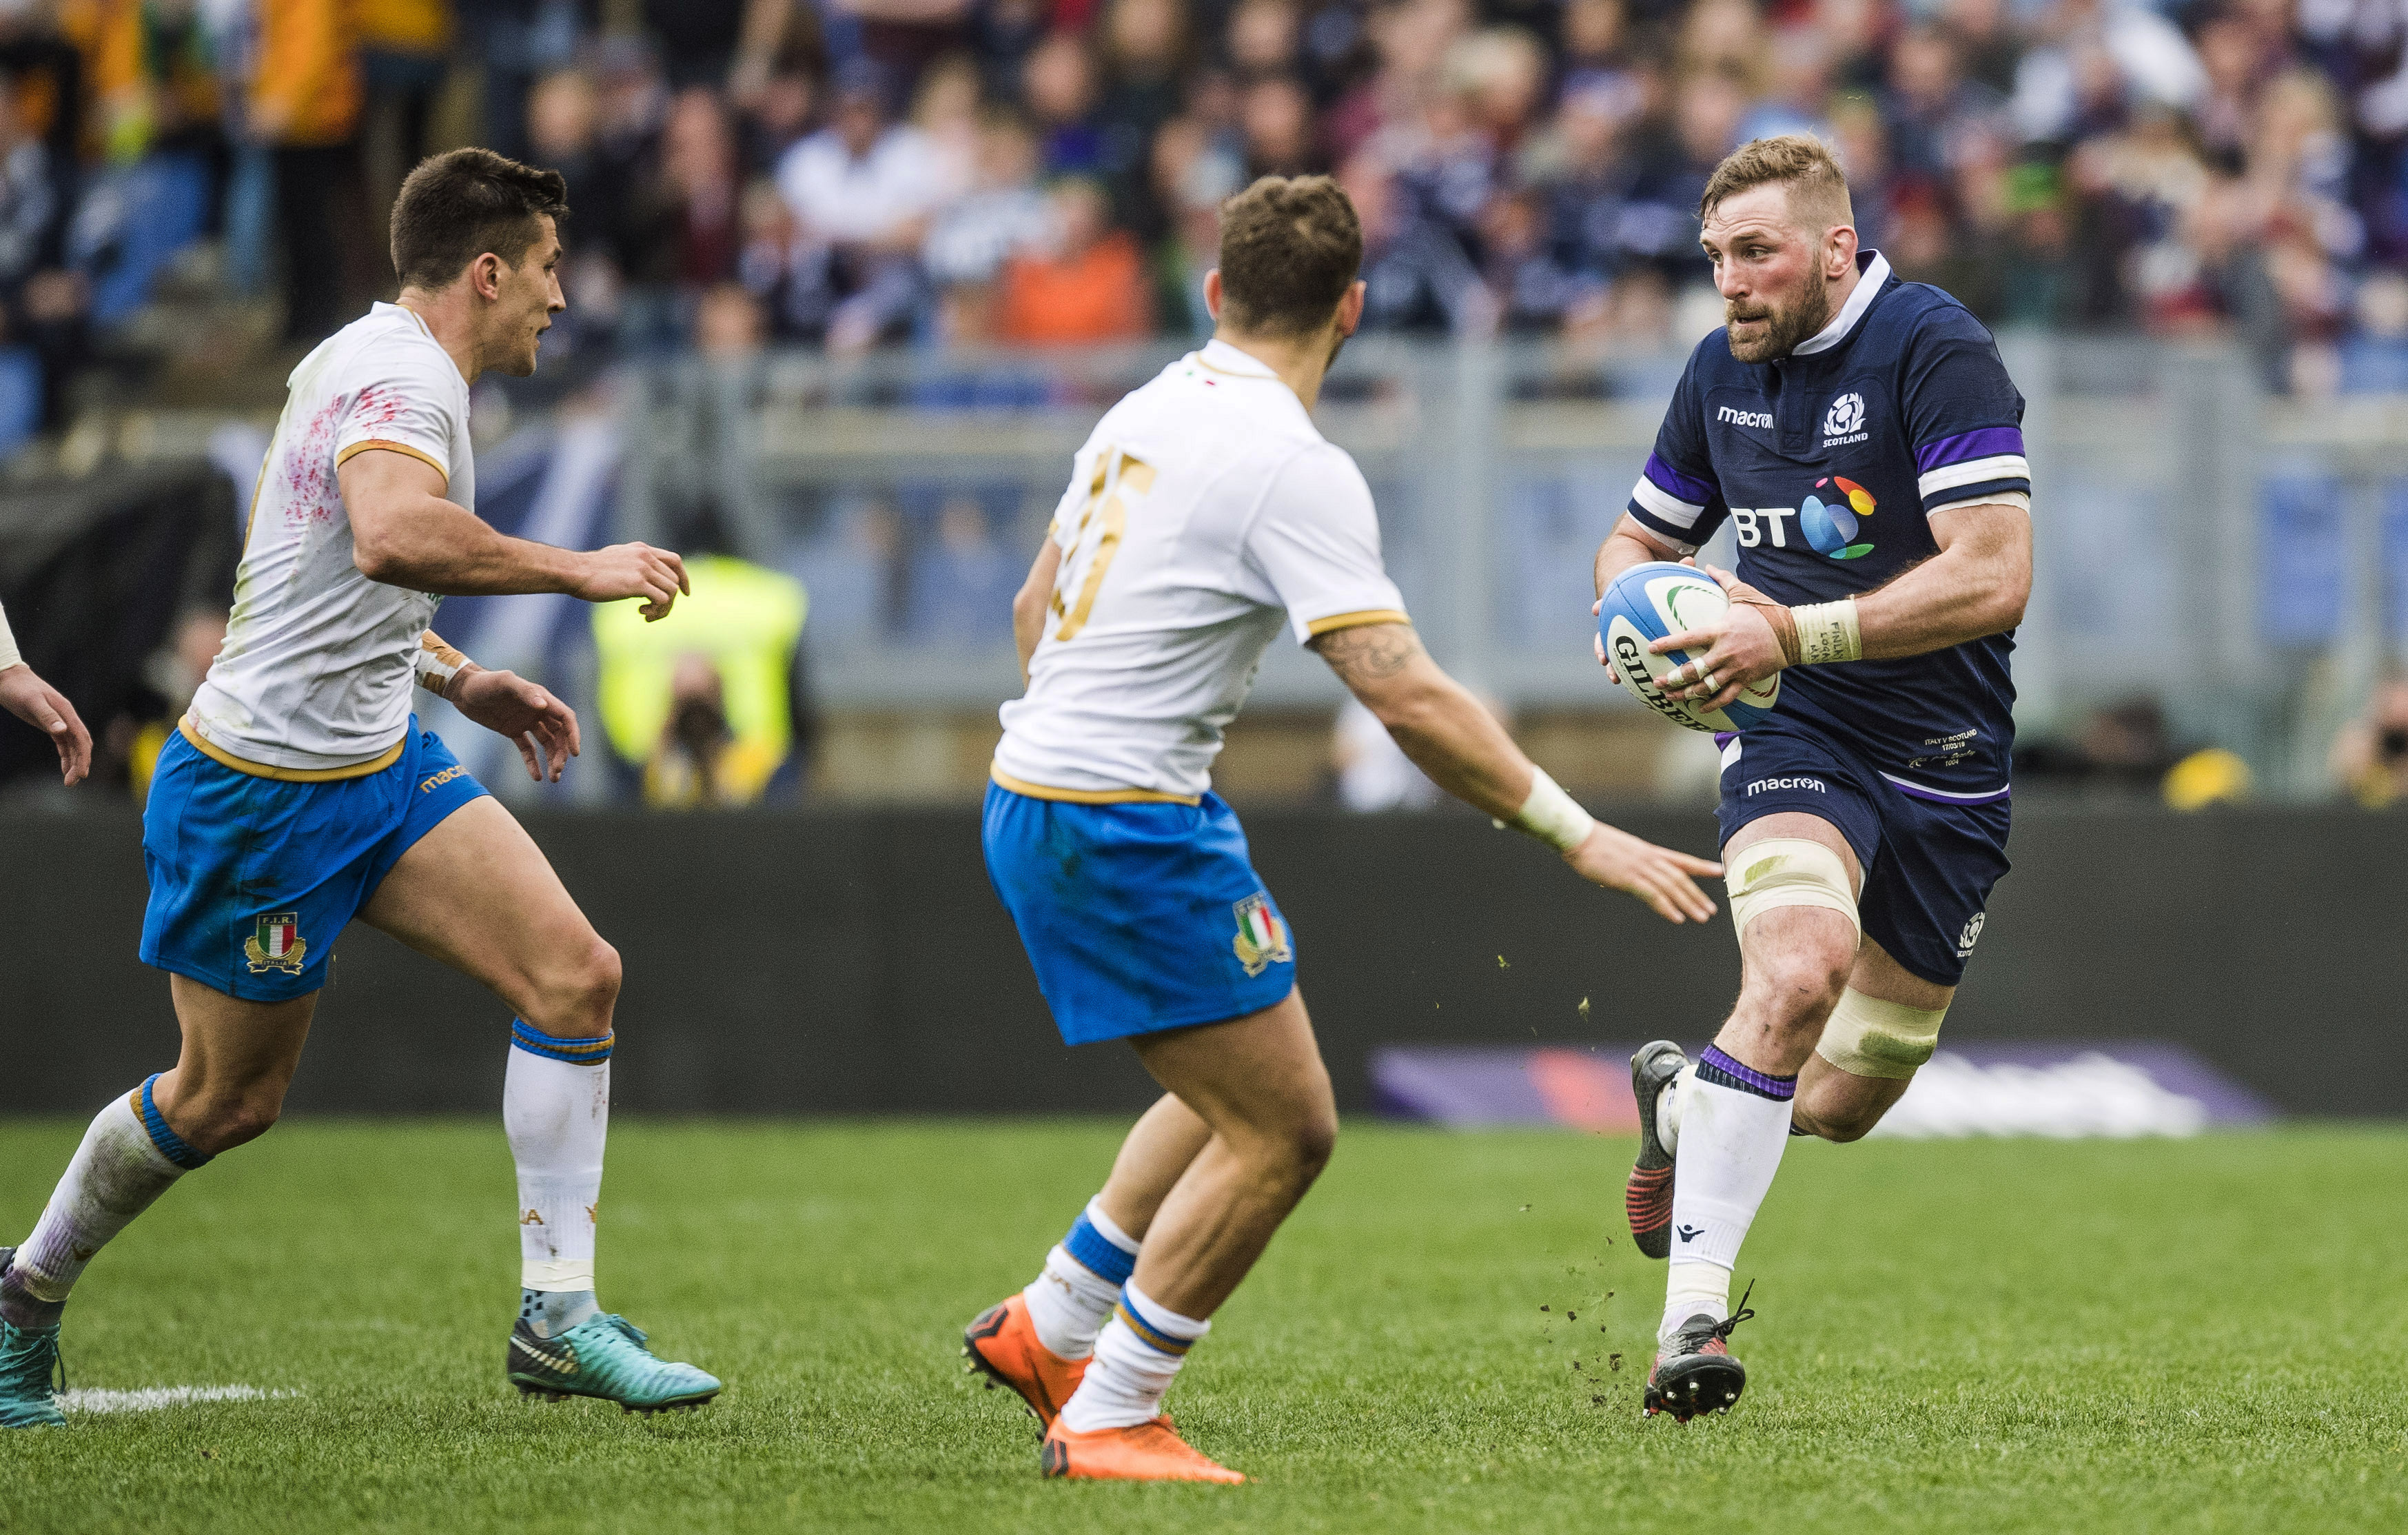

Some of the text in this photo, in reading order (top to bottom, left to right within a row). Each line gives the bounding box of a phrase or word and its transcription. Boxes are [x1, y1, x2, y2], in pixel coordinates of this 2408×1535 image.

[1822, 432, 1868, 448] SCOTLAND
[1730, 507, 1796, 547] BT
[1948, 729, 1977, 742] SCOTLAND
[1942, 741, 1966, 751] 17/03/18
[1747, 777, 1826, 797] macron
